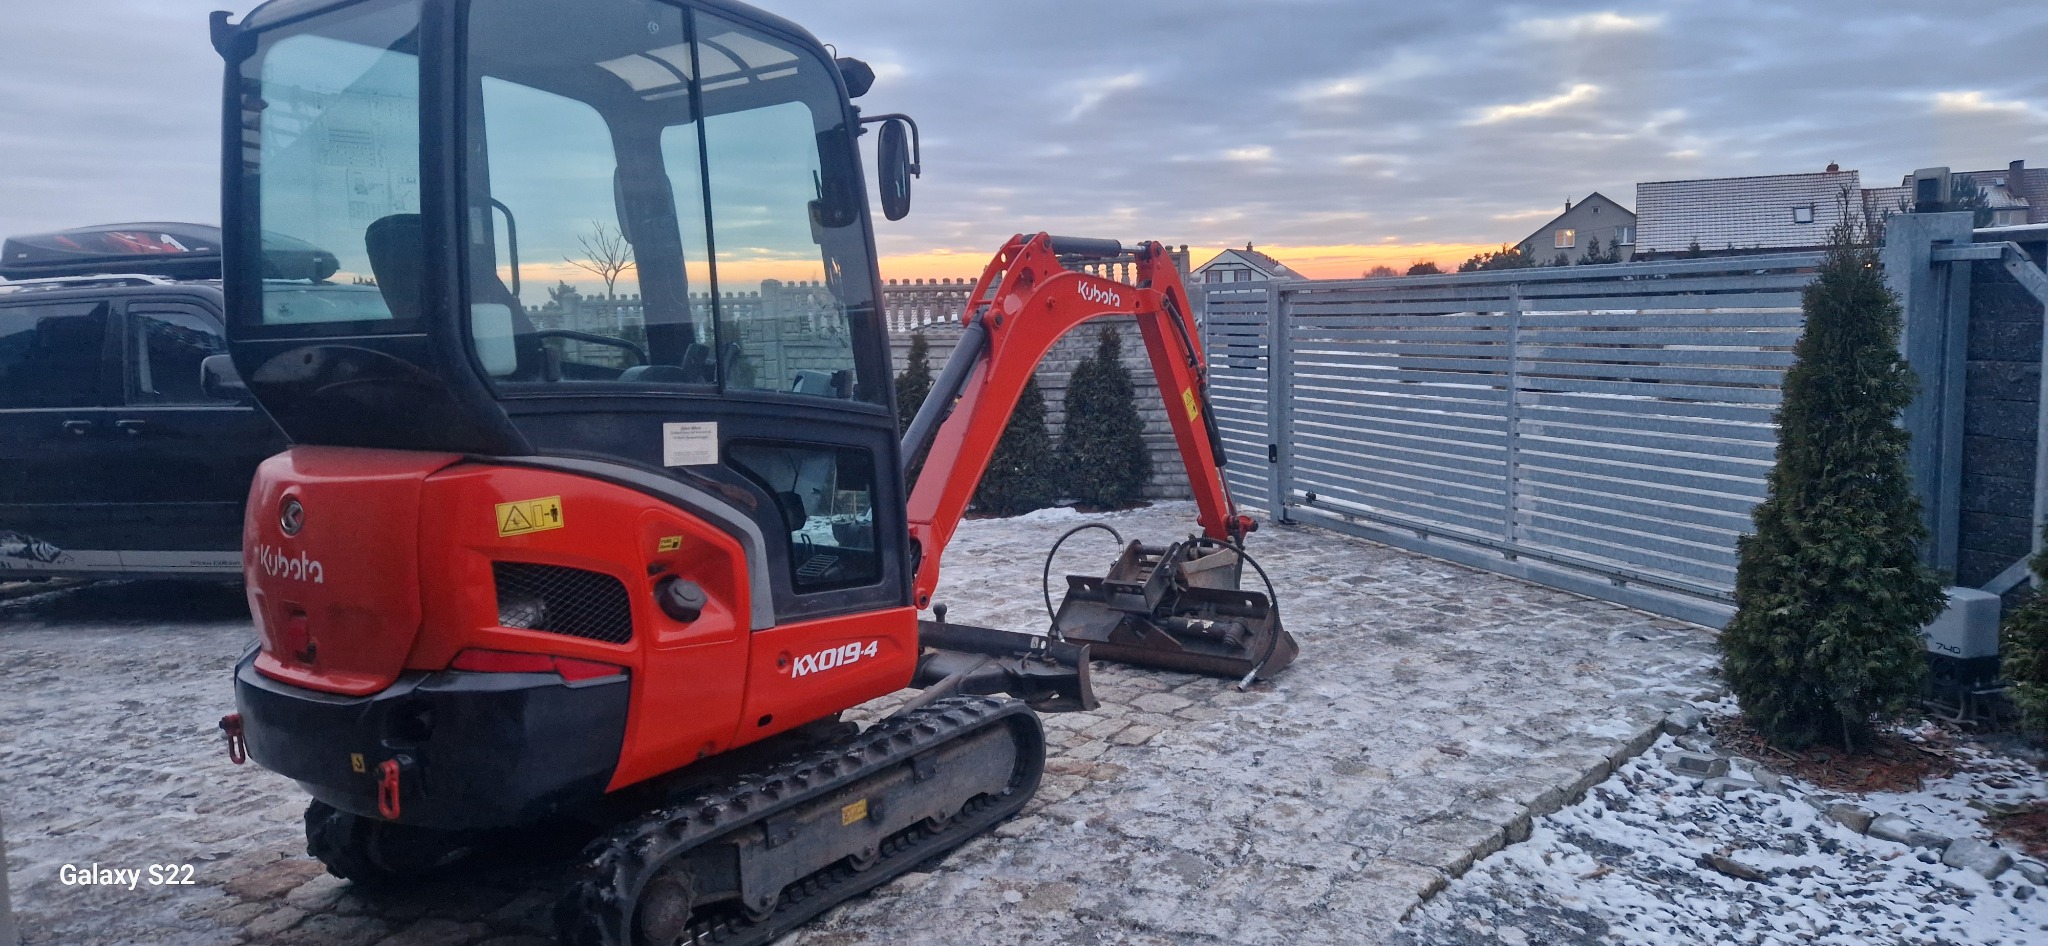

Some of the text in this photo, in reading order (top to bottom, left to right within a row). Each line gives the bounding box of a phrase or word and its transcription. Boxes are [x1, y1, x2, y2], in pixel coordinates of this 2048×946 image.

[1077, 280, 1120, 307] Kubota
[260, 543, 324, 584] Kubota
[791, 640, 878, 679] KX019-4
